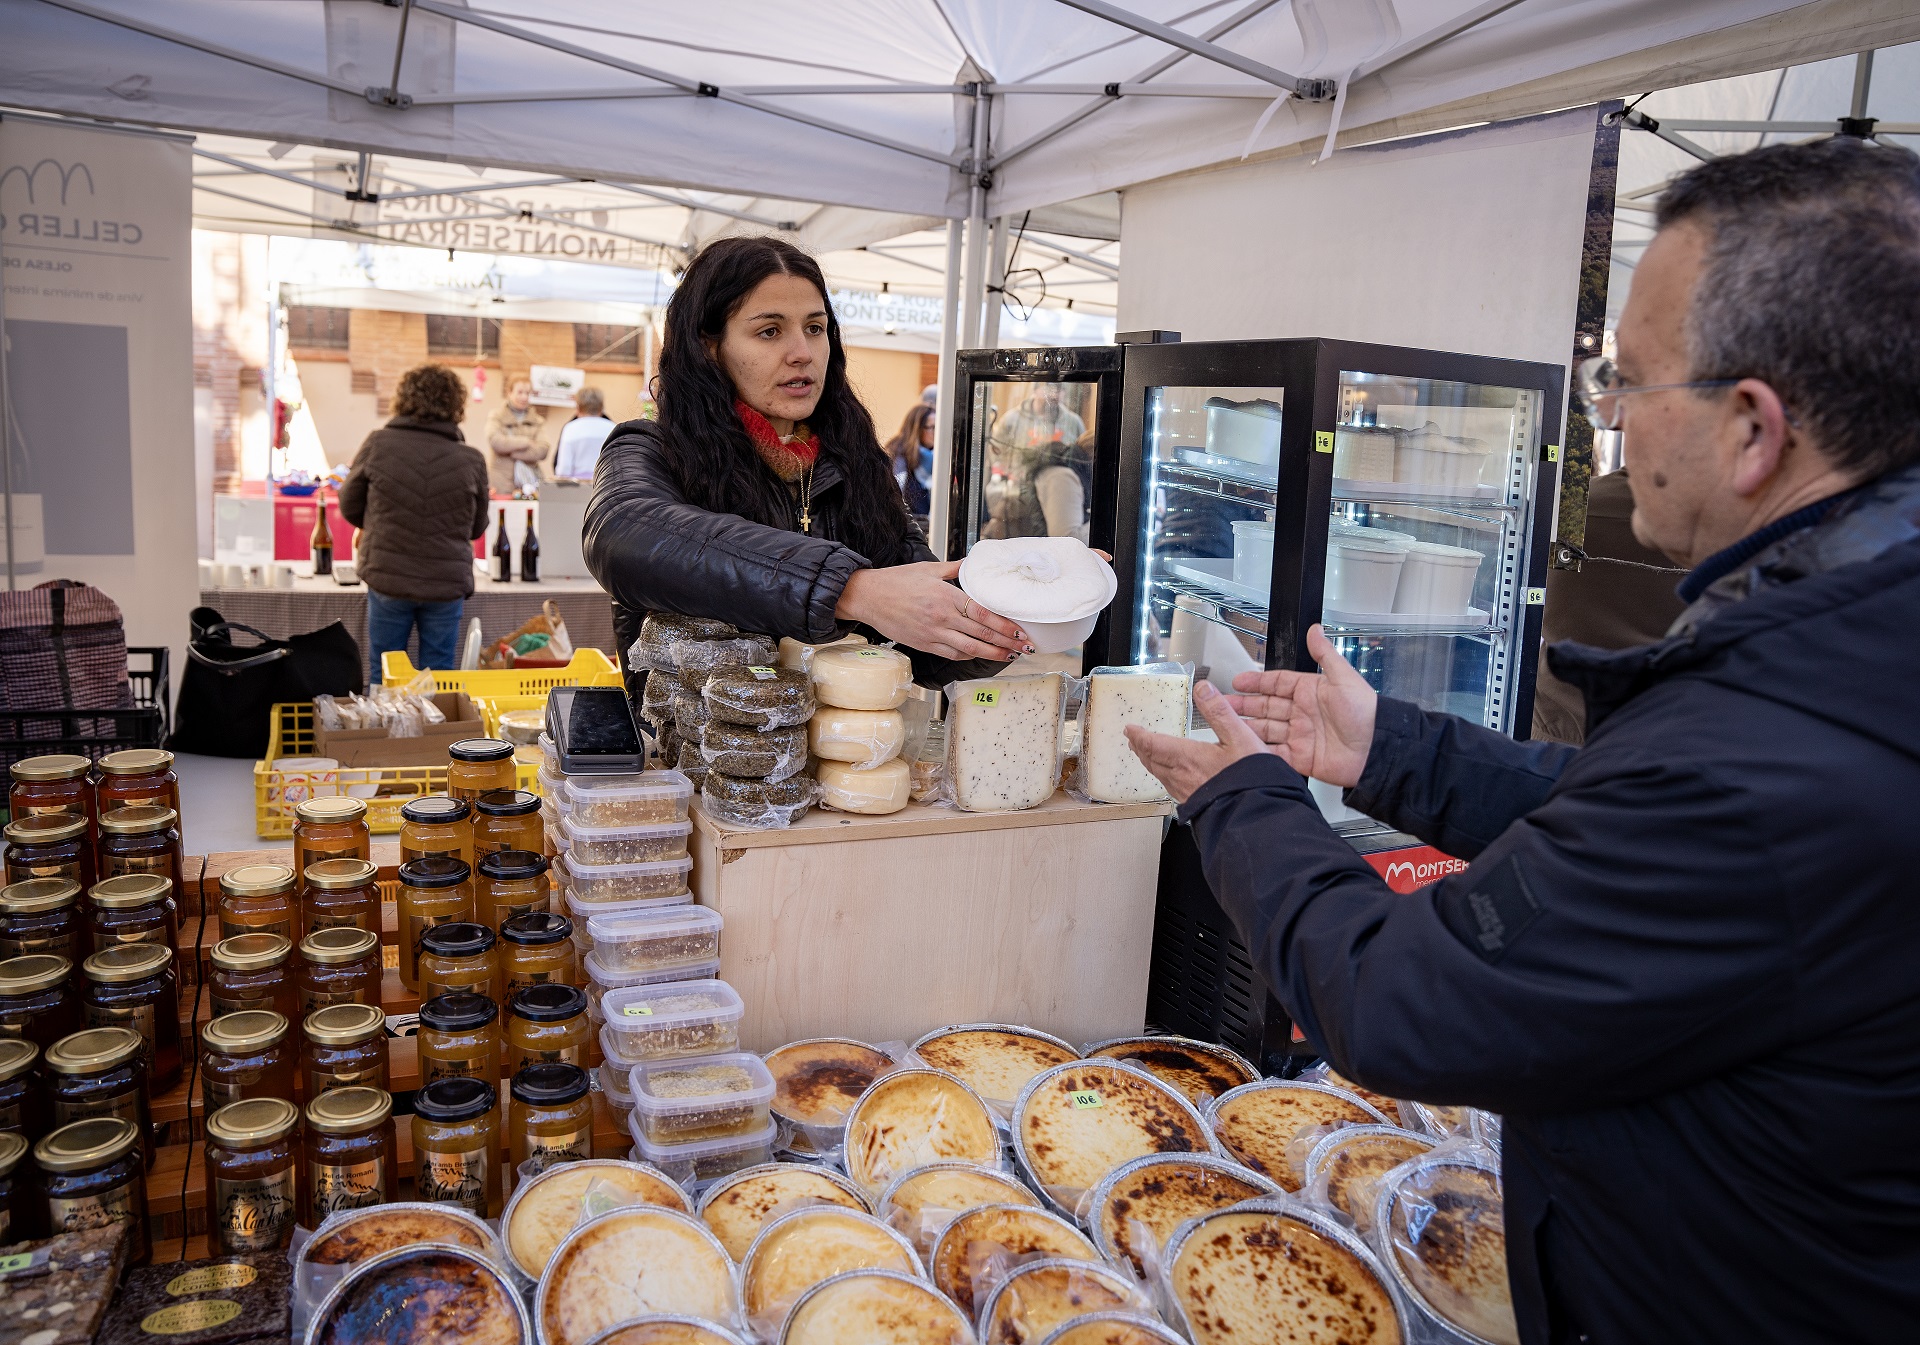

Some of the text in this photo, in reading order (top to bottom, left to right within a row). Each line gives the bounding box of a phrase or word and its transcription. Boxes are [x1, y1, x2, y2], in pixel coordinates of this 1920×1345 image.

[832, 303, 944, 325] ONTSERRA
[976, 692, 994, 703] 12€
[462, 1065, 484, 1073] Bresca
[1077, 1095, 1096, 1104] 10€
[565, 1138, 585, 1148] Bresca
[426, 1159, 437, 1167] Mel
[454, 1159, 479, 1168] Bresca
[435, 1179, 453, 1201] Can
[332, 1193, 352, 1212] Can
[243, 1206, 265, 1230] Can
[183, 1275, 207, 1283] Can
